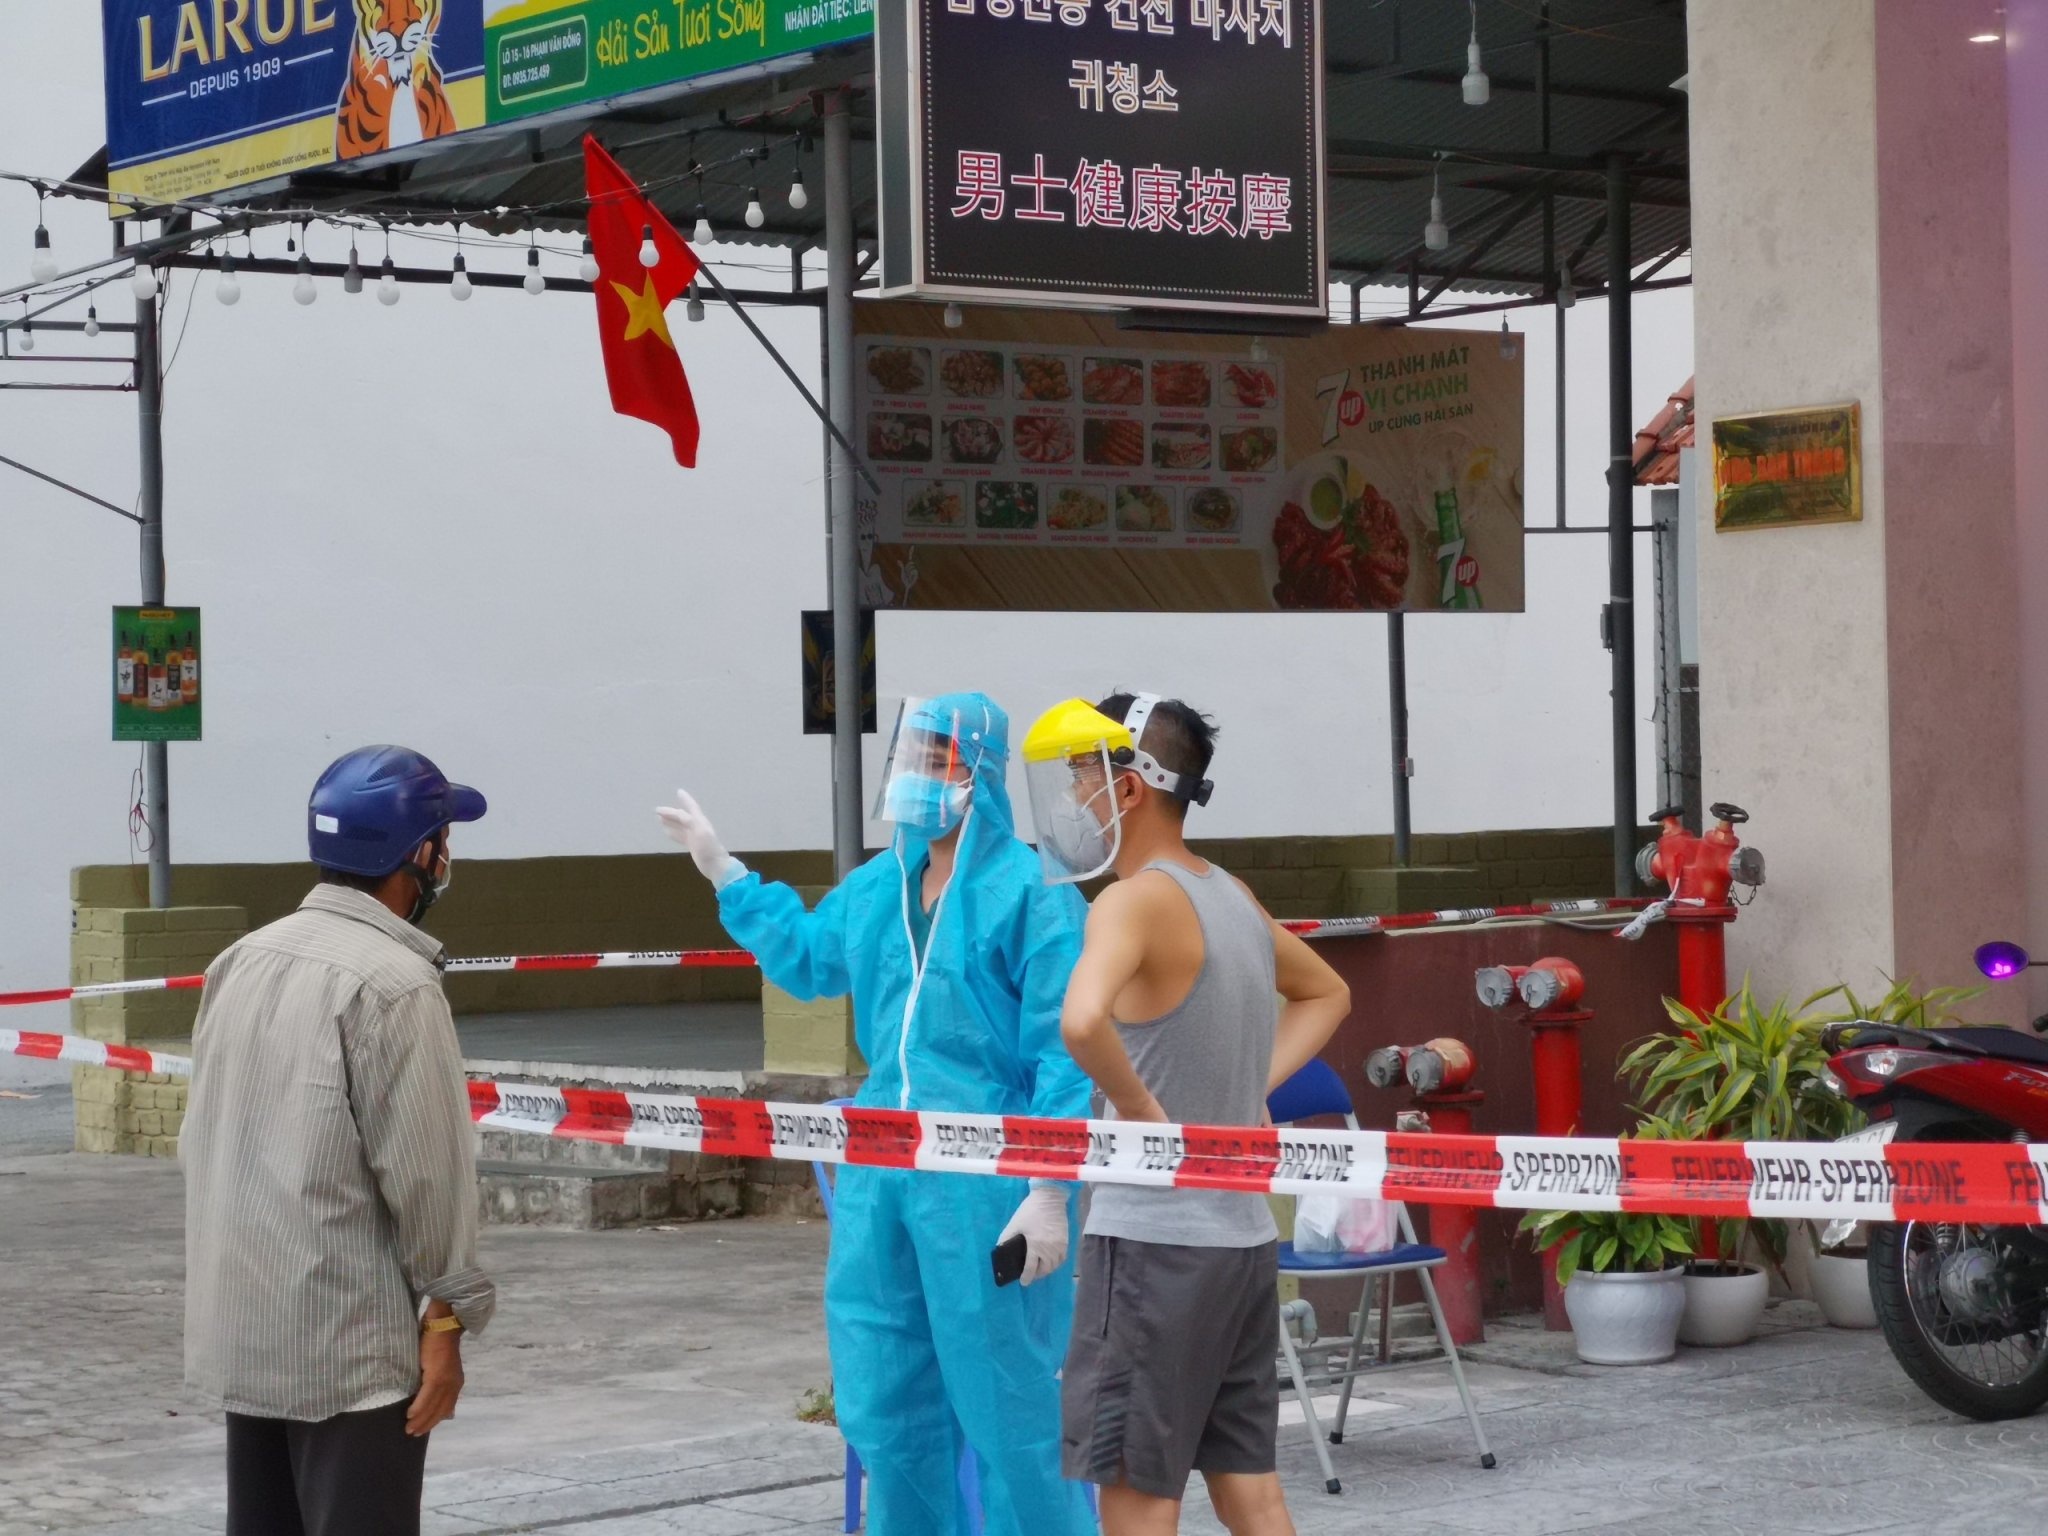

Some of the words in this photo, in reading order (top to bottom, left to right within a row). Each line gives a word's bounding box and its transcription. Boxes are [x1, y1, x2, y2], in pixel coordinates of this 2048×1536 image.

[137, 0, 336, 82] LARUE
[596, 19, 629, 68] Hải
[634, 9, 669, 59] Sản
[1190, 0, 1292, 49] 마사지
[190, 69, 239, 99] DEPUIS
[243, 57, 281, 83] 1909
[511, 48, 519, 63] 15
[1068, 59, 1180, 115] 귀청소
[950, 149, 1293, 241] 男士健康按摩
[1360, 354, 1425, 384] THANH
[1430, 344, 1470, 369] MÁT
[1364, 387, 1387, 413] VỊ
[1392, 373, 1469, 406] CHANH
[1368, 417, 1384, 433] UP
[1385, 1146, 1637, 1196] FEUERWEHR-SPERRZONE
[1672, 1156, 1968, 1205] FEUERWEHR-SPERRZONE
